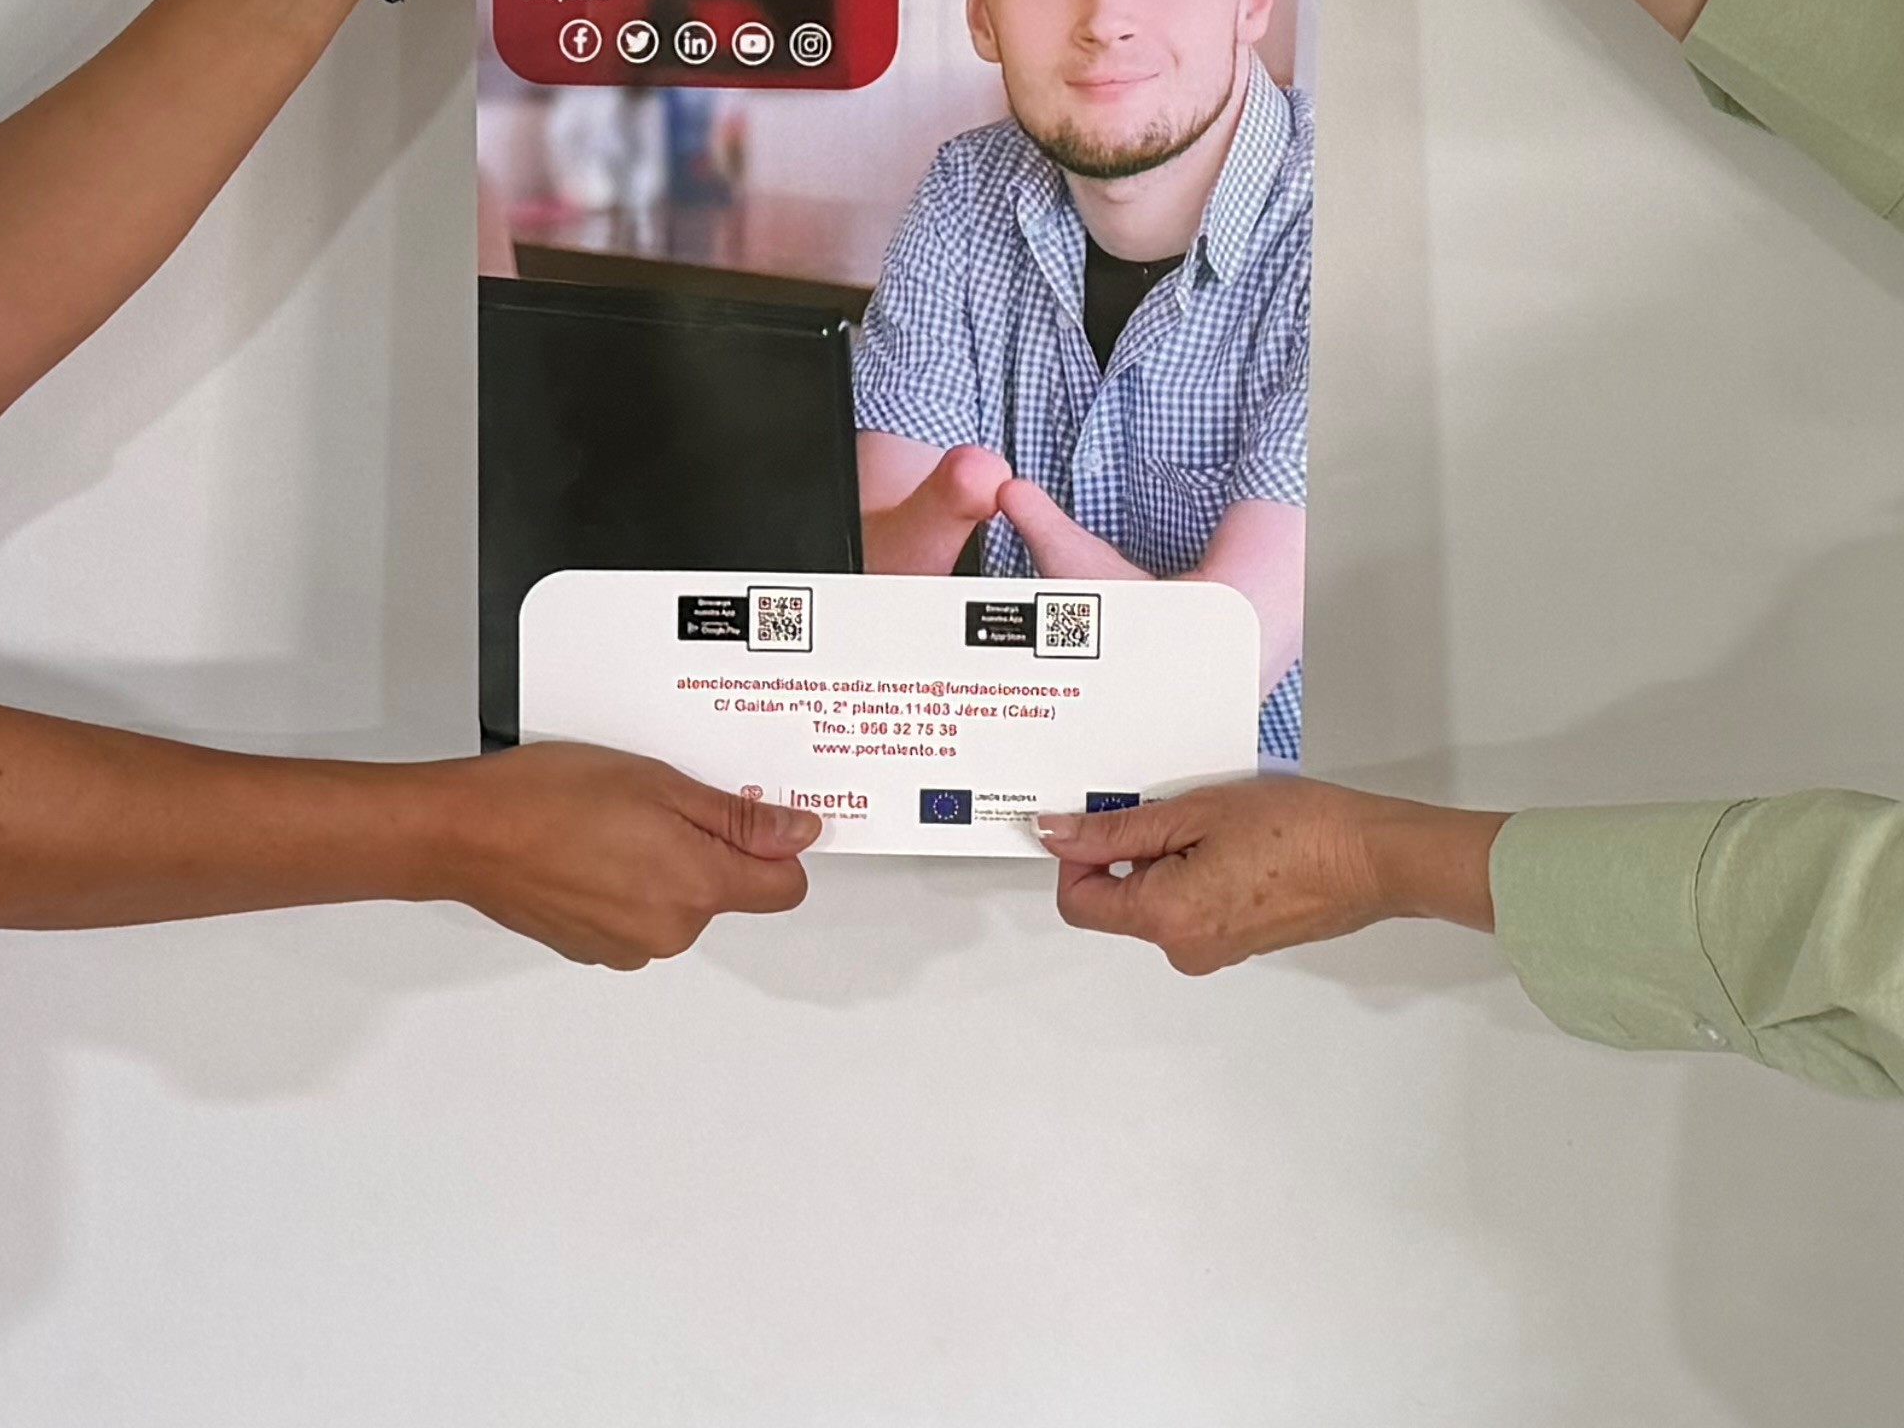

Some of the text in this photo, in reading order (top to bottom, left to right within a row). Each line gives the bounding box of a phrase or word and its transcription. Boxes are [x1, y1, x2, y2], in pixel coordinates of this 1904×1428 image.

[713, 698, 730, 712] C/
[734, 698, 785, 712] Gaitán
[1002, 704, 1057, 721] (Cádiz)
[893, 723, 912, 736] 32
[916, 723, 935, 736] 75
[938, 724, 958, 737] 38
[812, 743, 957, 758] www.portalento.es
[790, 789, 868, 809] Inserta
